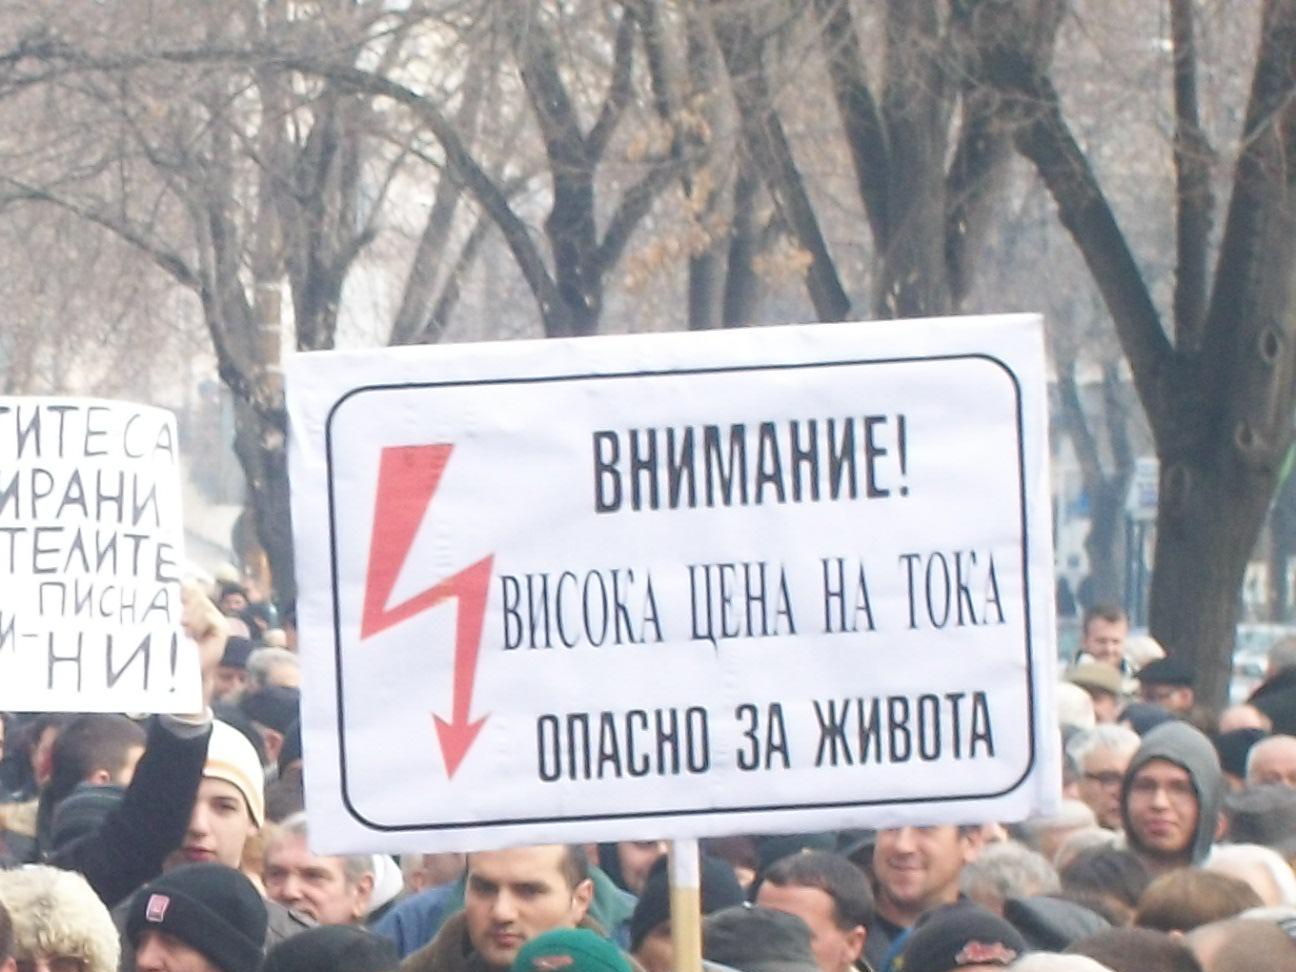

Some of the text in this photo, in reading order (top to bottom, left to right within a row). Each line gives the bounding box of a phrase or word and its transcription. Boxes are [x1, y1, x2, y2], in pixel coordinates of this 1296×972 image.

[122, 412, 176, 465] СА
[591, 413, 910, 514] ВНИМАНИЕ!
[39, 580, 170, 624] ПИСНА
[500, 549, 1008, 660] ВИСОКА ЦЕНА НА ТОКА
[47, 630, 179, 693] НИ!
[536, 689, 996, 784] ОПАСНО ЗА ЖИВОТА
